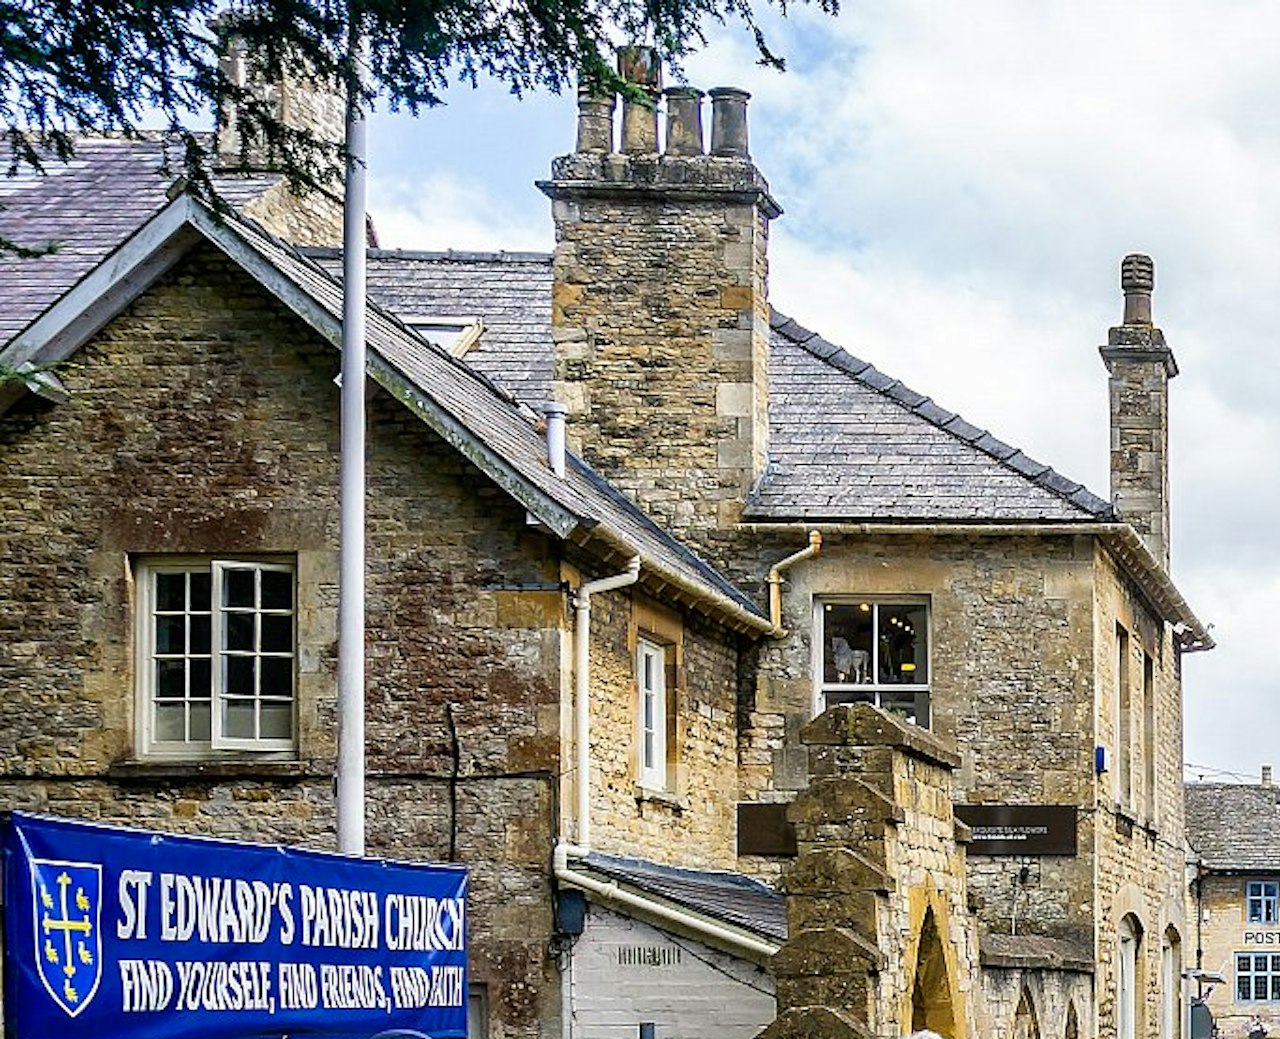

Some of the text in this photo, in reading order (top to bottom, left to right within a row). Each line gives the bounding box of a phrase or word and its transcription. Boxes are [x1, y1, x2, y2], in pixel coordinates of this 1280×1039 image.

[117, 869, 465, 951] ST EDWARD'S PARISH CHURCH
[117, 959, 465, 1015] FIND YOURSELF, FIND FRIENDS, FIND FAITH
